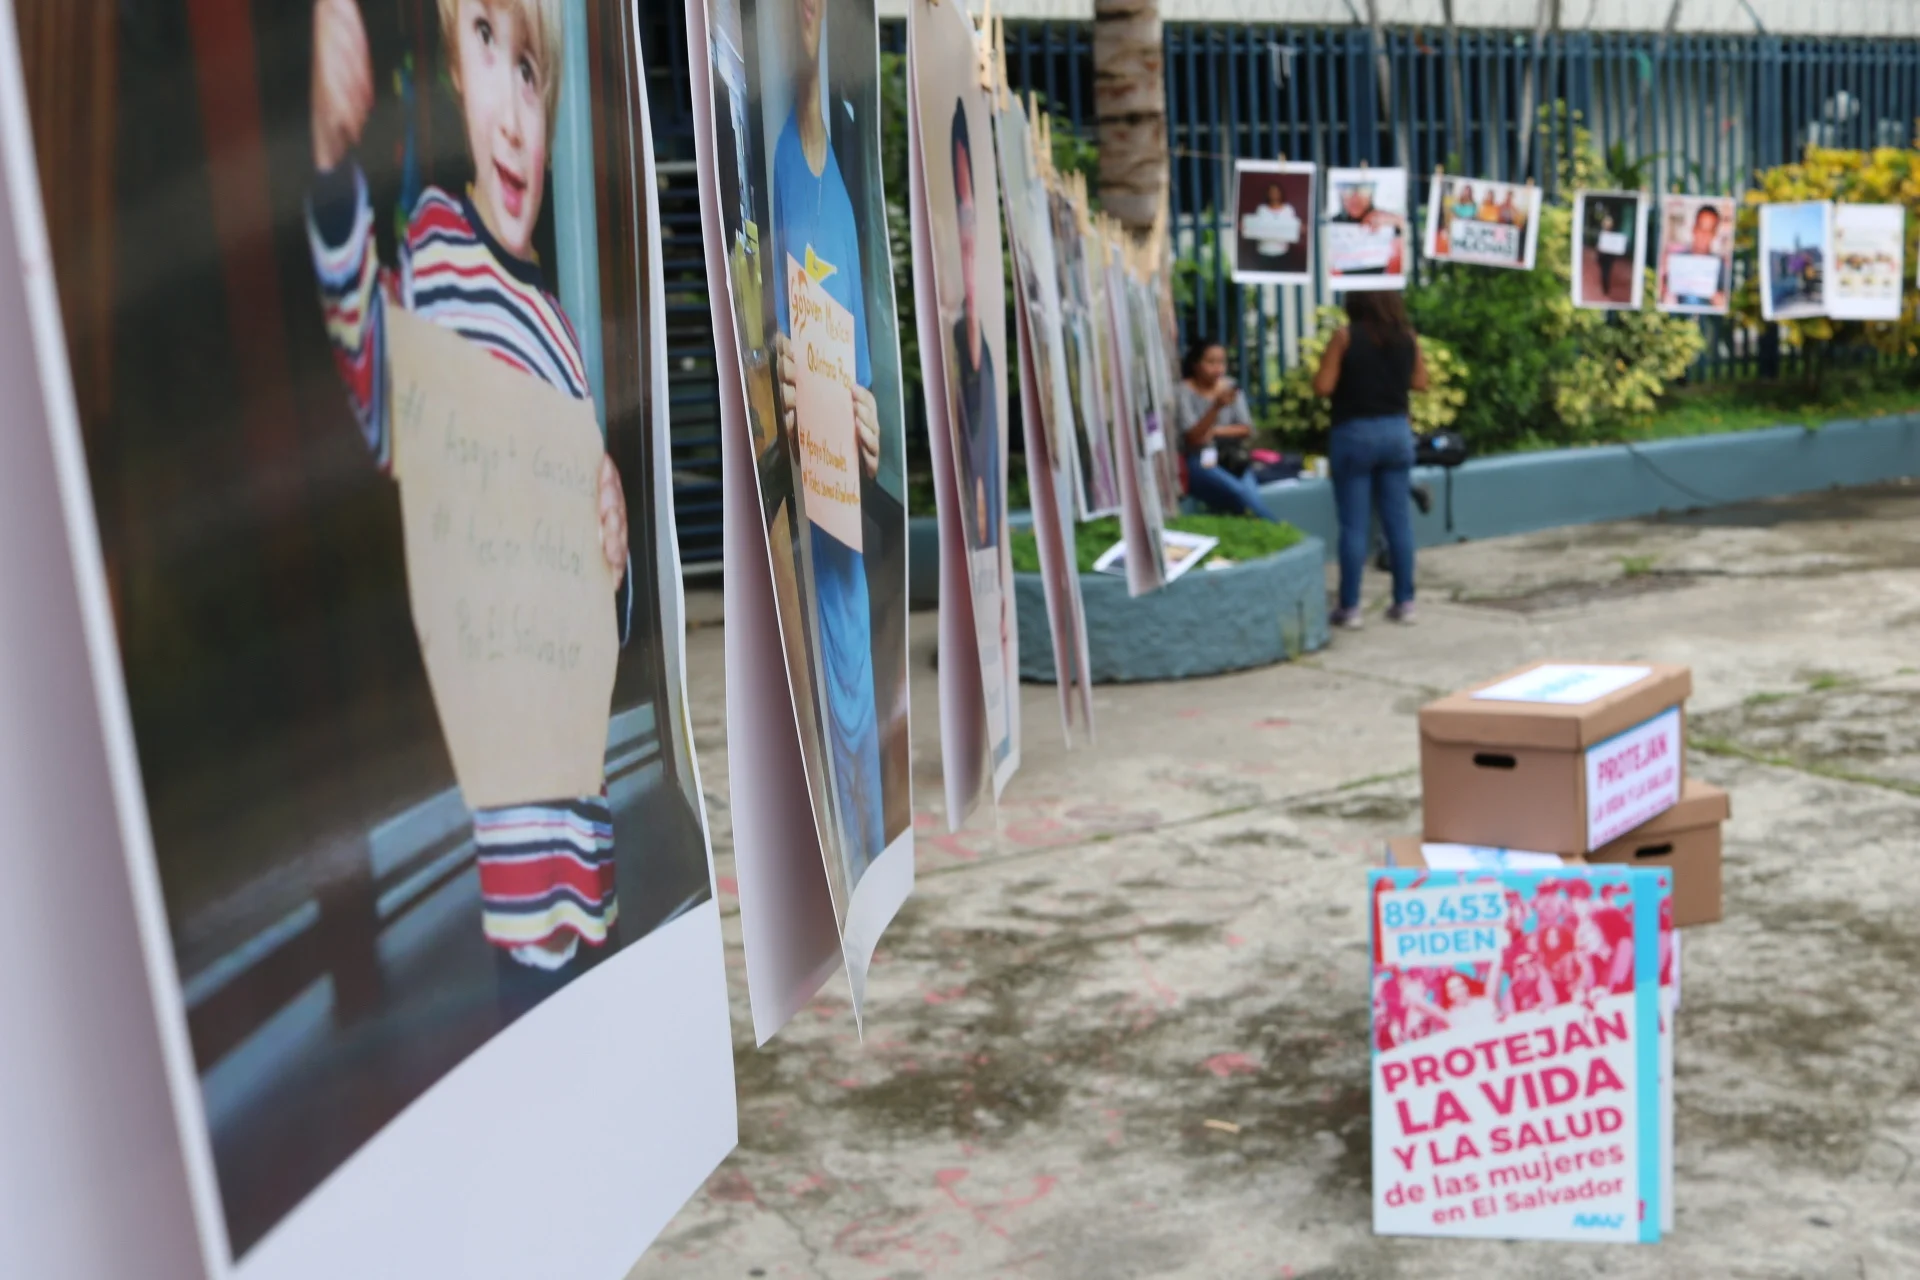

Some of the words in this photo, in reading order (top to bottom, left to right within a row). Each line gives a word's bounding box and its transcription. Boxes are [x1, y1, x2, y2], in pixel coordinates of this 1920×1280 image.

[1397, 928, 1497, 957] PIDEN
[1380, 1010, 1630, 1094] PROTEJAN
[1395, 1089, 1473, 1137] LA
[1478, 1056, 1626, 1117] VIDA
[1392, 1144, 1417, 1172] Y
[1427, 1134, 1481, 1167] LA
[1488, 1105, 1625, 1155] SALUD
[1384, 1181, 1425, 1208] de
[1432, 1170, 1481, 1198] las
[1488, 1144, 1625, 1188] mujeres
[1431, 1203, 1466, 1225] en
[1471, 1195, 1498, 1219] El
[1504, 1176, 1626, 1213] Salvador
